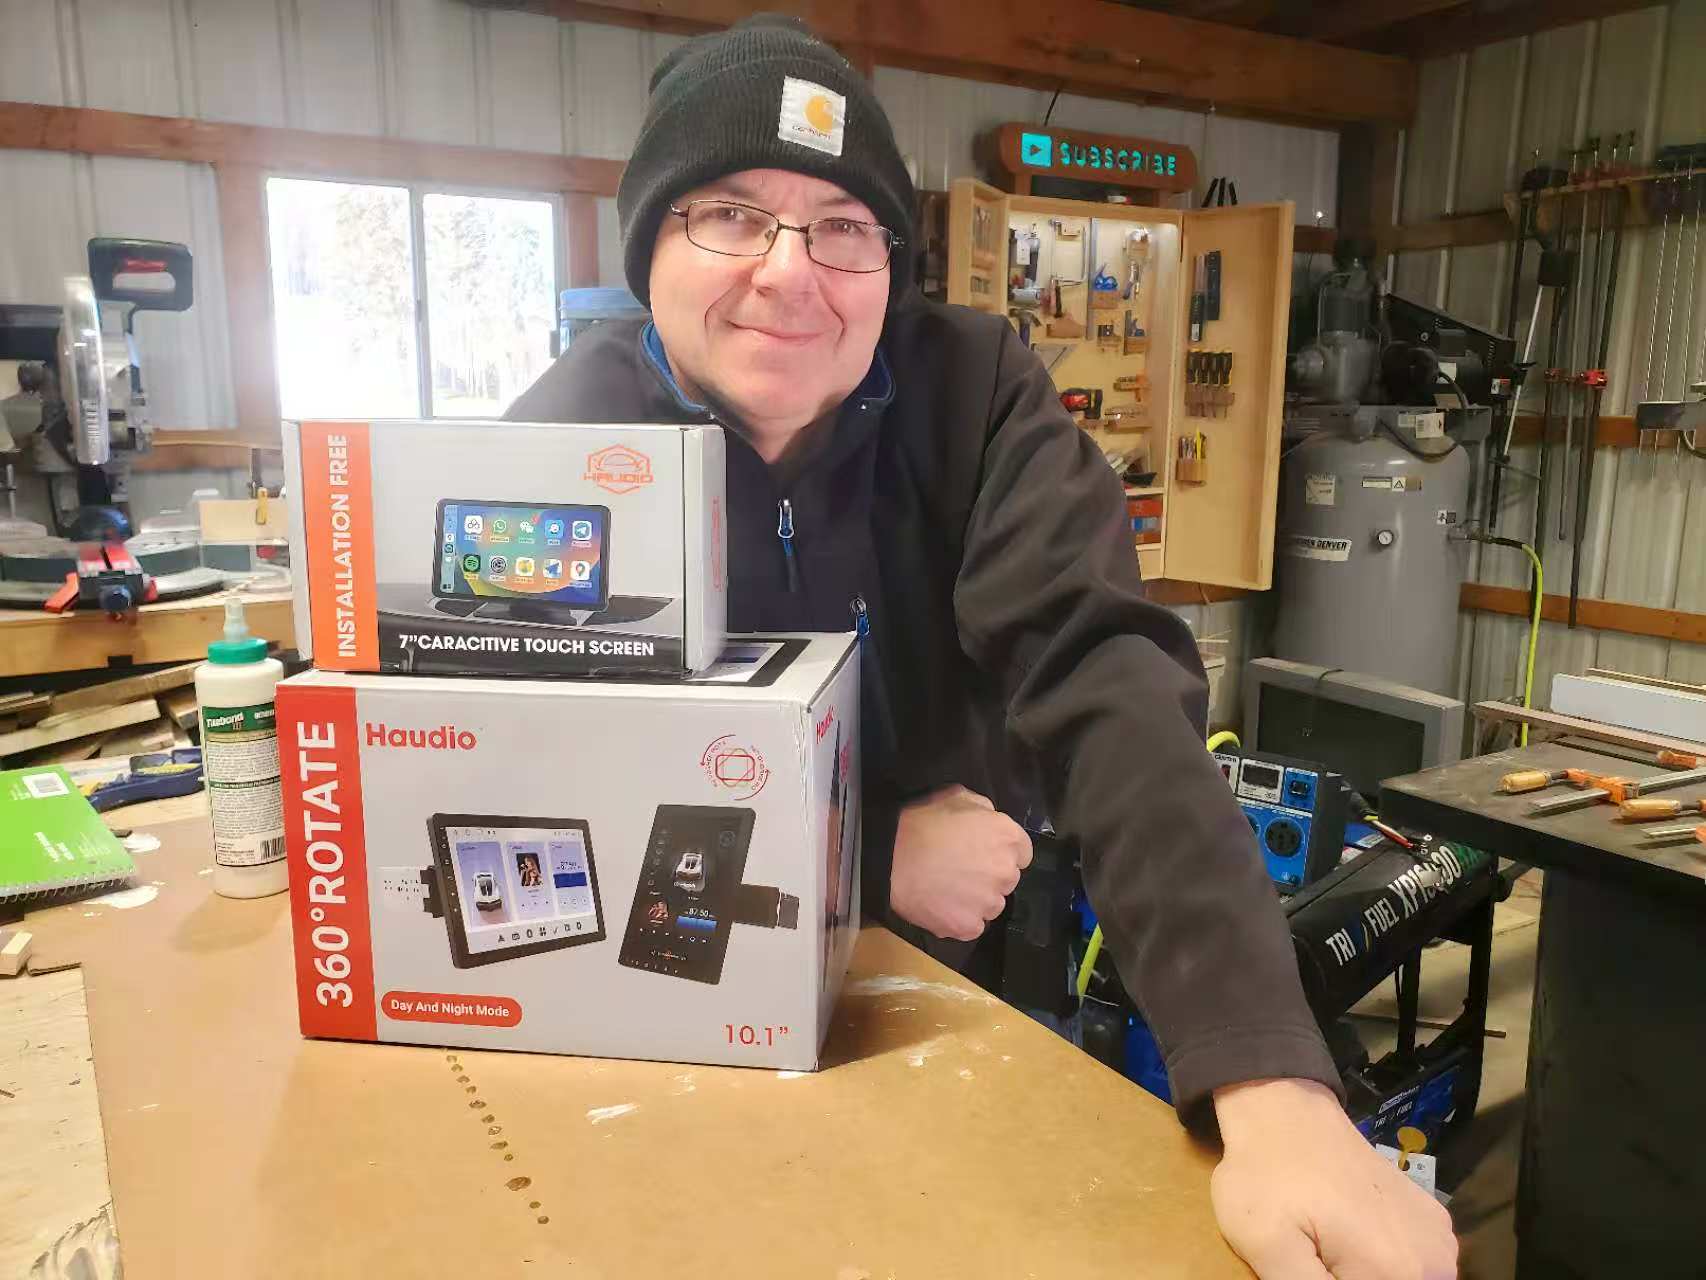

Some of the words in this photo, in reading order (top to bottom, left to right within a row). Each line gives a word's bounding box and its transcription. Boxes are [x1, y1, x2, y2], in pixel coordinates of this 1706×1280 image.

[1060, 142, 1176, 176] SUBSCRIBE
[328, 434, 349, 486] FREE
[331, 494, 357, 657] INSTALLATION
[524, 637, 585, 655] TOUCH
[589, 640, 655, 657] SCREEN
[365, 722, 477, 750] Haudio
[1325, 927, 1357, 967] TRI
[1364, 897, 1400, 938] FUEL
[391, 999, 414, 1013] Day
[416, 1001, 438, 1013] And
[441, 1003, 473, 1017] Night
[476, 1005, 510, 1018] Mode
